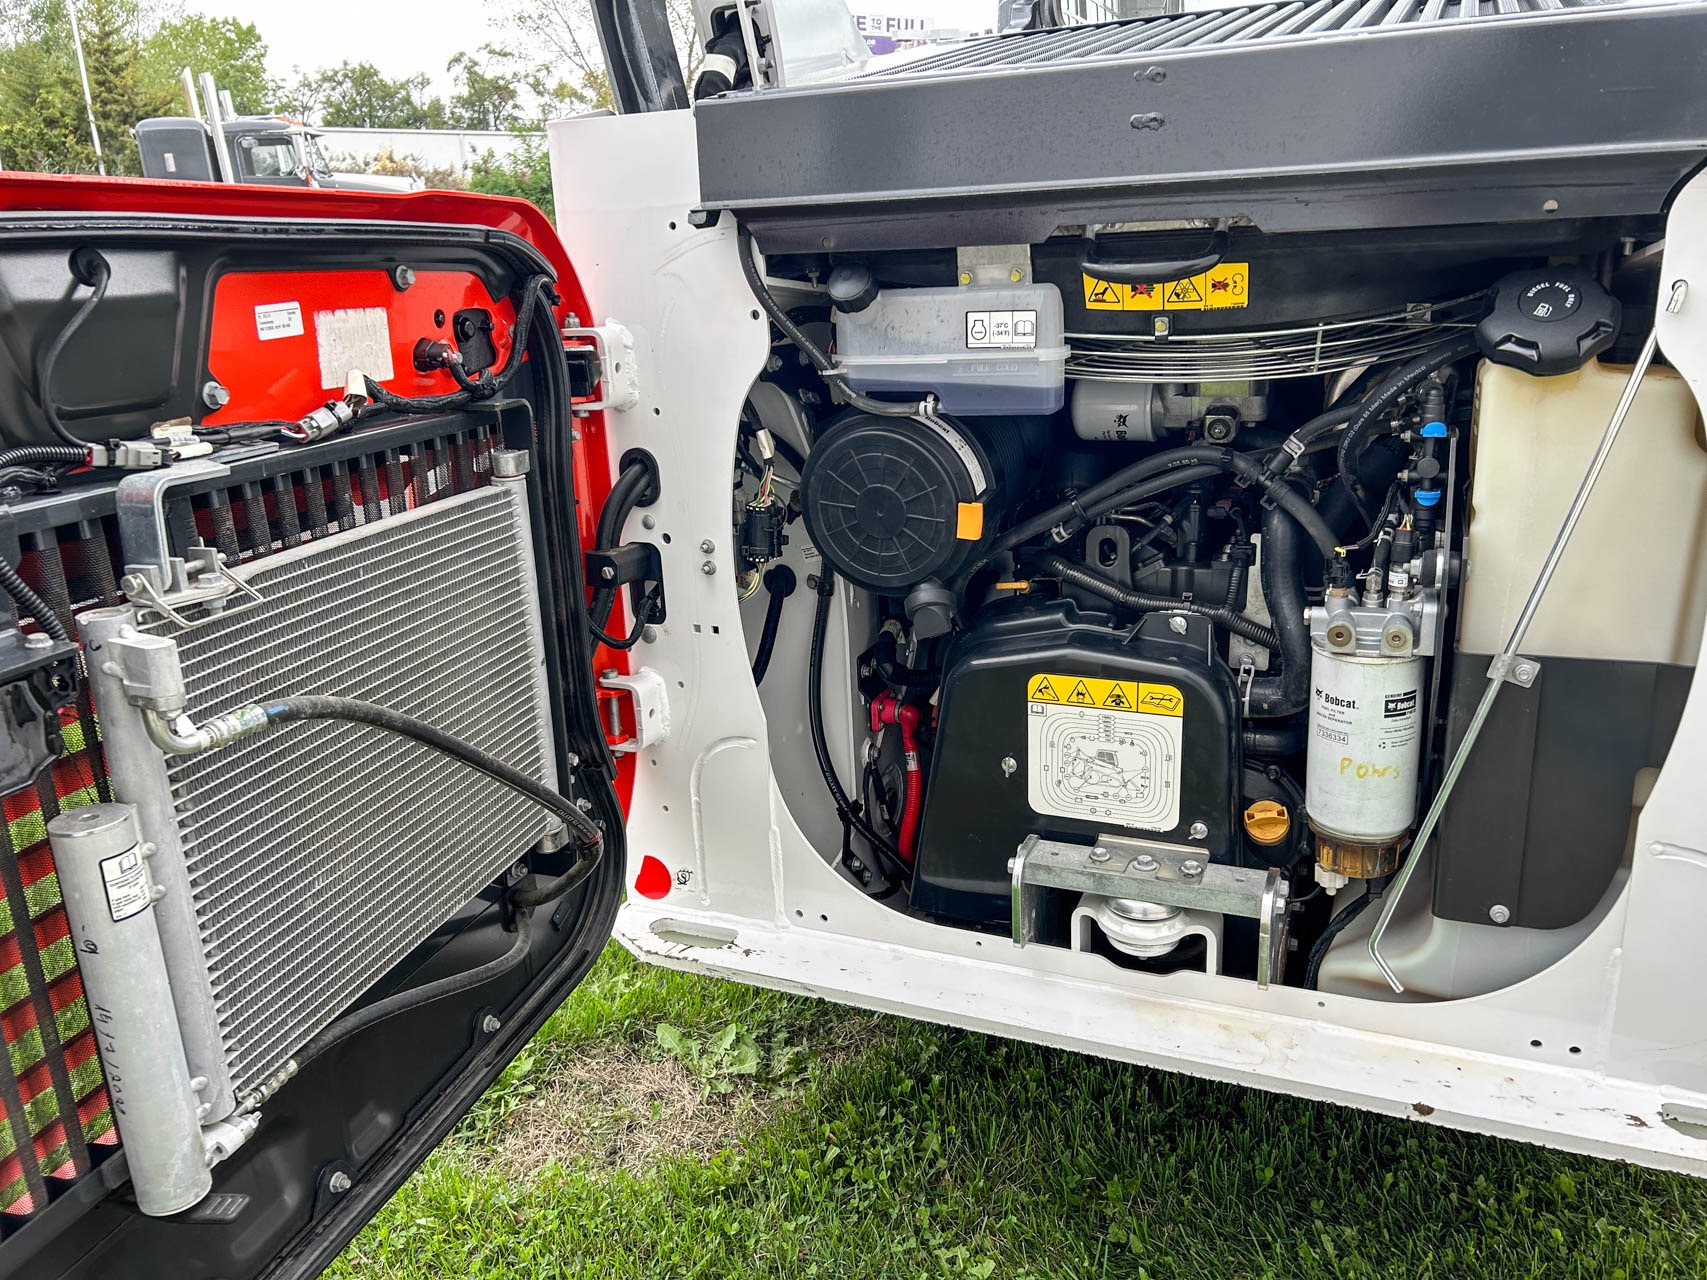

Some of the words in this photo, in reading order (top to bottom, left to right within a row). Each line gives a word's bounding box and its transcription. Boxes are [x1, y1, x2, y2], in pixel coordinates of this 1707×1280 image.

[1526, 282, 1550, 297] DIESEL
[1554, 282, 1571, 293] FUEL
[971, 364, 991, 372] FULL
[996, 363, 1018, 371] COLD
[1380, 385, 1398, 400] Made
[1403, 365, 1427, 382] Mexico
[925, 415, 951, 434] Bobcat
[1325, 693, 1356, 710] Bobcat
[1397, 699, 1415, 710] Bobcat
[1318, 728, 1347, 743] 7336334
